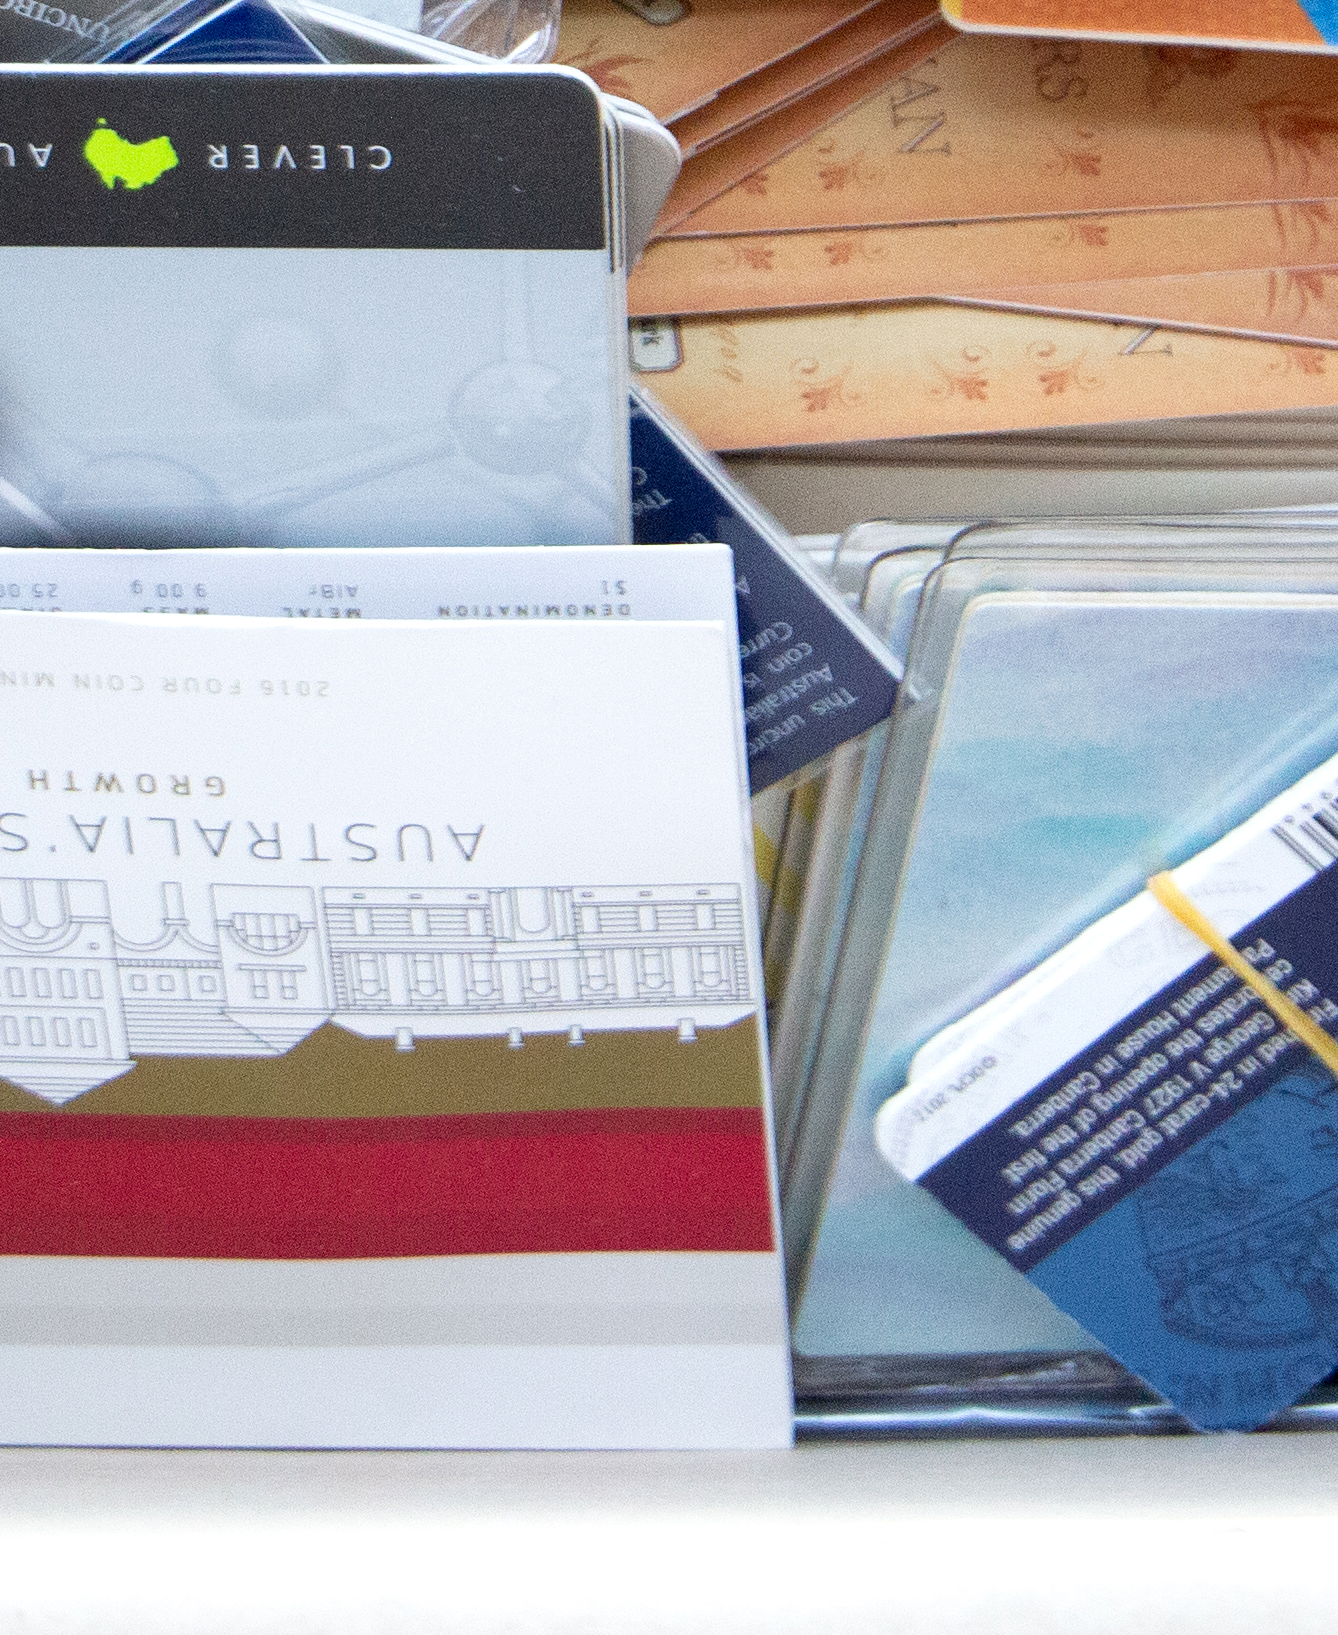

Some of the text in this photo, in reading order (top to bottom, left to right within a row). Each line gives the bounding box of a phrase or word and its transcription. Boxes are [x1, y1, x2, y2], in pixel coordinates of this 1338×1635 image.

[207, 143, 393, 170] CLEVER
[437, 603, 633, 619] DENOMINATION
[764, 638, 816, 677] coin
[73, 671, 145, 693] COIN
[164, 674, 242, 696] FOUR
[261, 677, 331, 698] 2016
[808, 682, 858, 722] This
[28, 768, 226, 798] GROWTH
[1115, 1008, 1178, 1064] House
[1165, 1026, 1203, 1061] the
[1202, 1005, 1274, 1068] George
[1089, 1047, 1169, 1116] opening
[1095, 1053, 1121, 1079] in
[1188, 1058, 1210, 1081] V
[1237, 1053, 1265, 1082] in
[1008, 1067, 1100, 1146] Canberra.
[1142, 1071, 1191, 1116] 1927
[1160, 1067, 1243, 1139] 24-carat
[1072, 1105, 1099, 1132] of
[1041, 1121, 1078, 1156] the
[1060, 1106, 1146, 1180] Canberra
[1001, 1145, 1046, 1186] first
[1079, 1163, 1118, 1199] this
[1004, 1165, 1068, 1223] Florin
[1003, 1185, 1084, 1254] genuine
